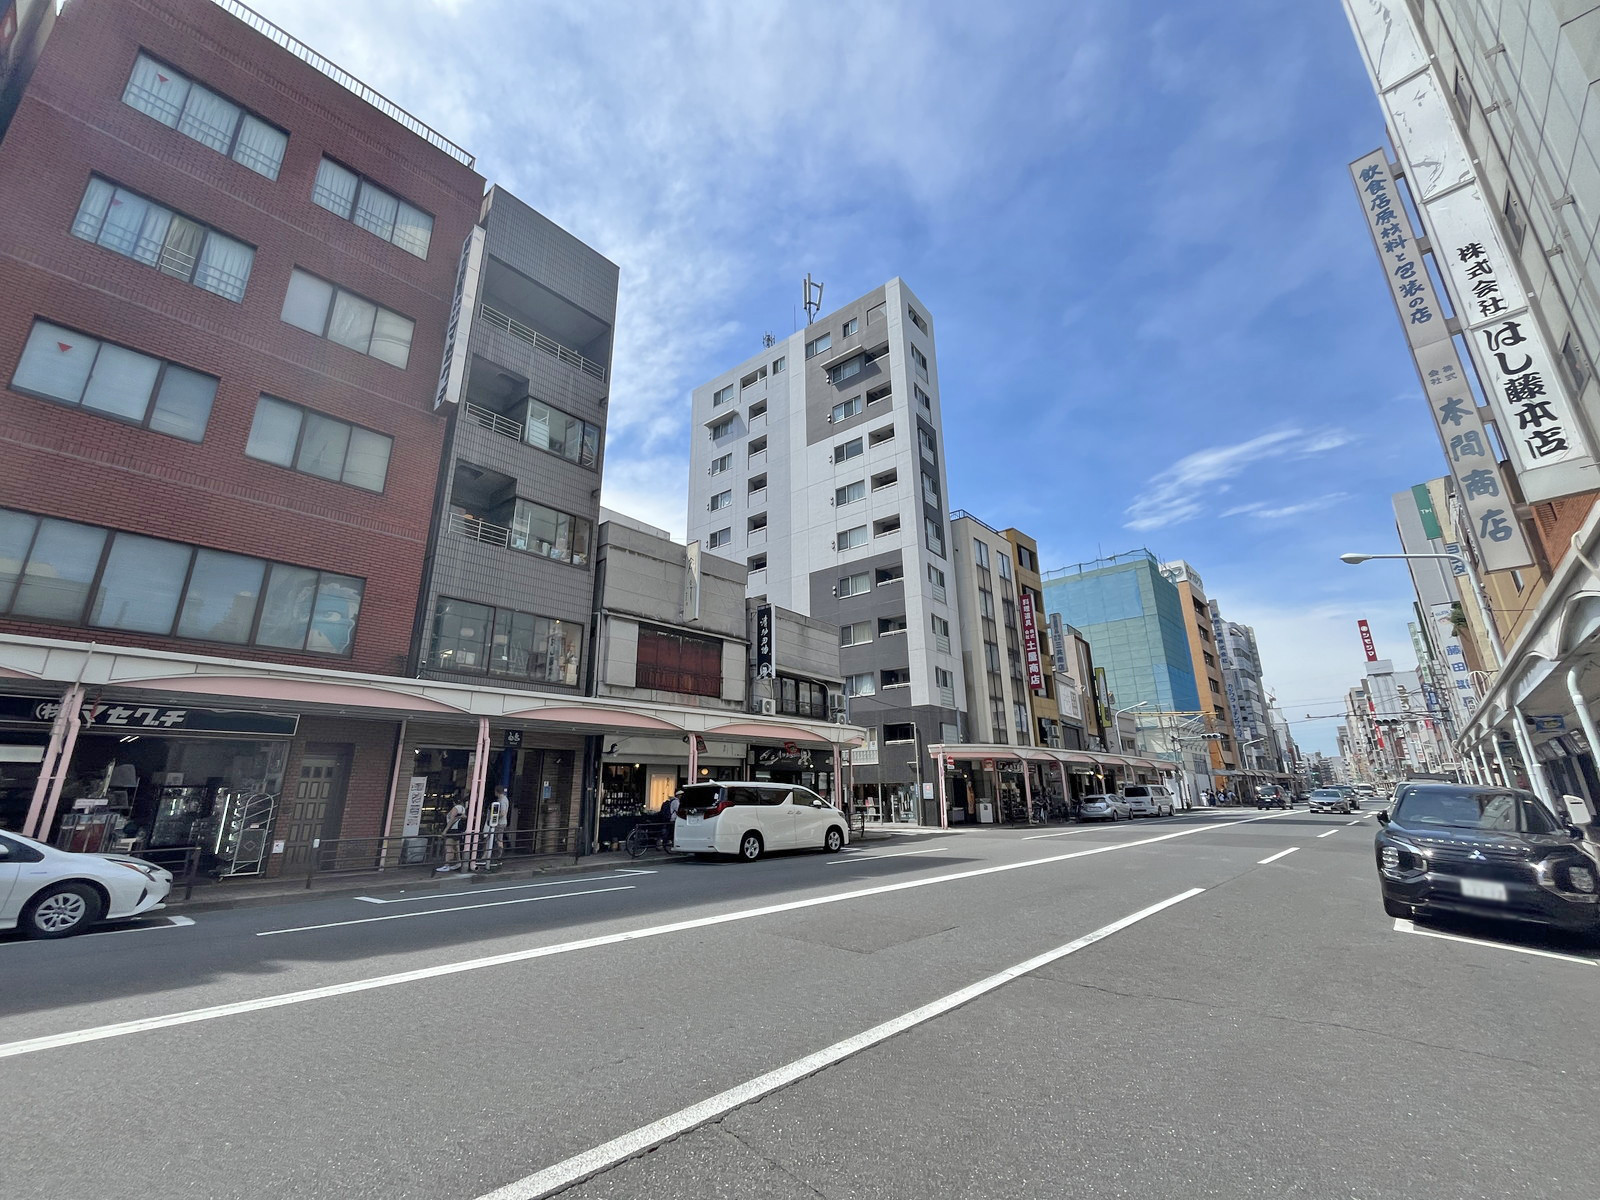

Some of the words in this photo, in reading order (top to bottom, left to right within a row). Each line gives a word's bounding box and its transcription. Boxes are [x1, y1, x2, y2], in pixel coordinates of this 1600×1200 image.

[1359, 163, 1433, 325] 飲食店原材料と包装の店
[1456, 242, 1508, 318] 株式会社
[1483, 321, 1569, 460] はし藤本店
[1439, 396, 1513, 542] 本間商店
[1027, 641, 1040, 685] 土屋商店
